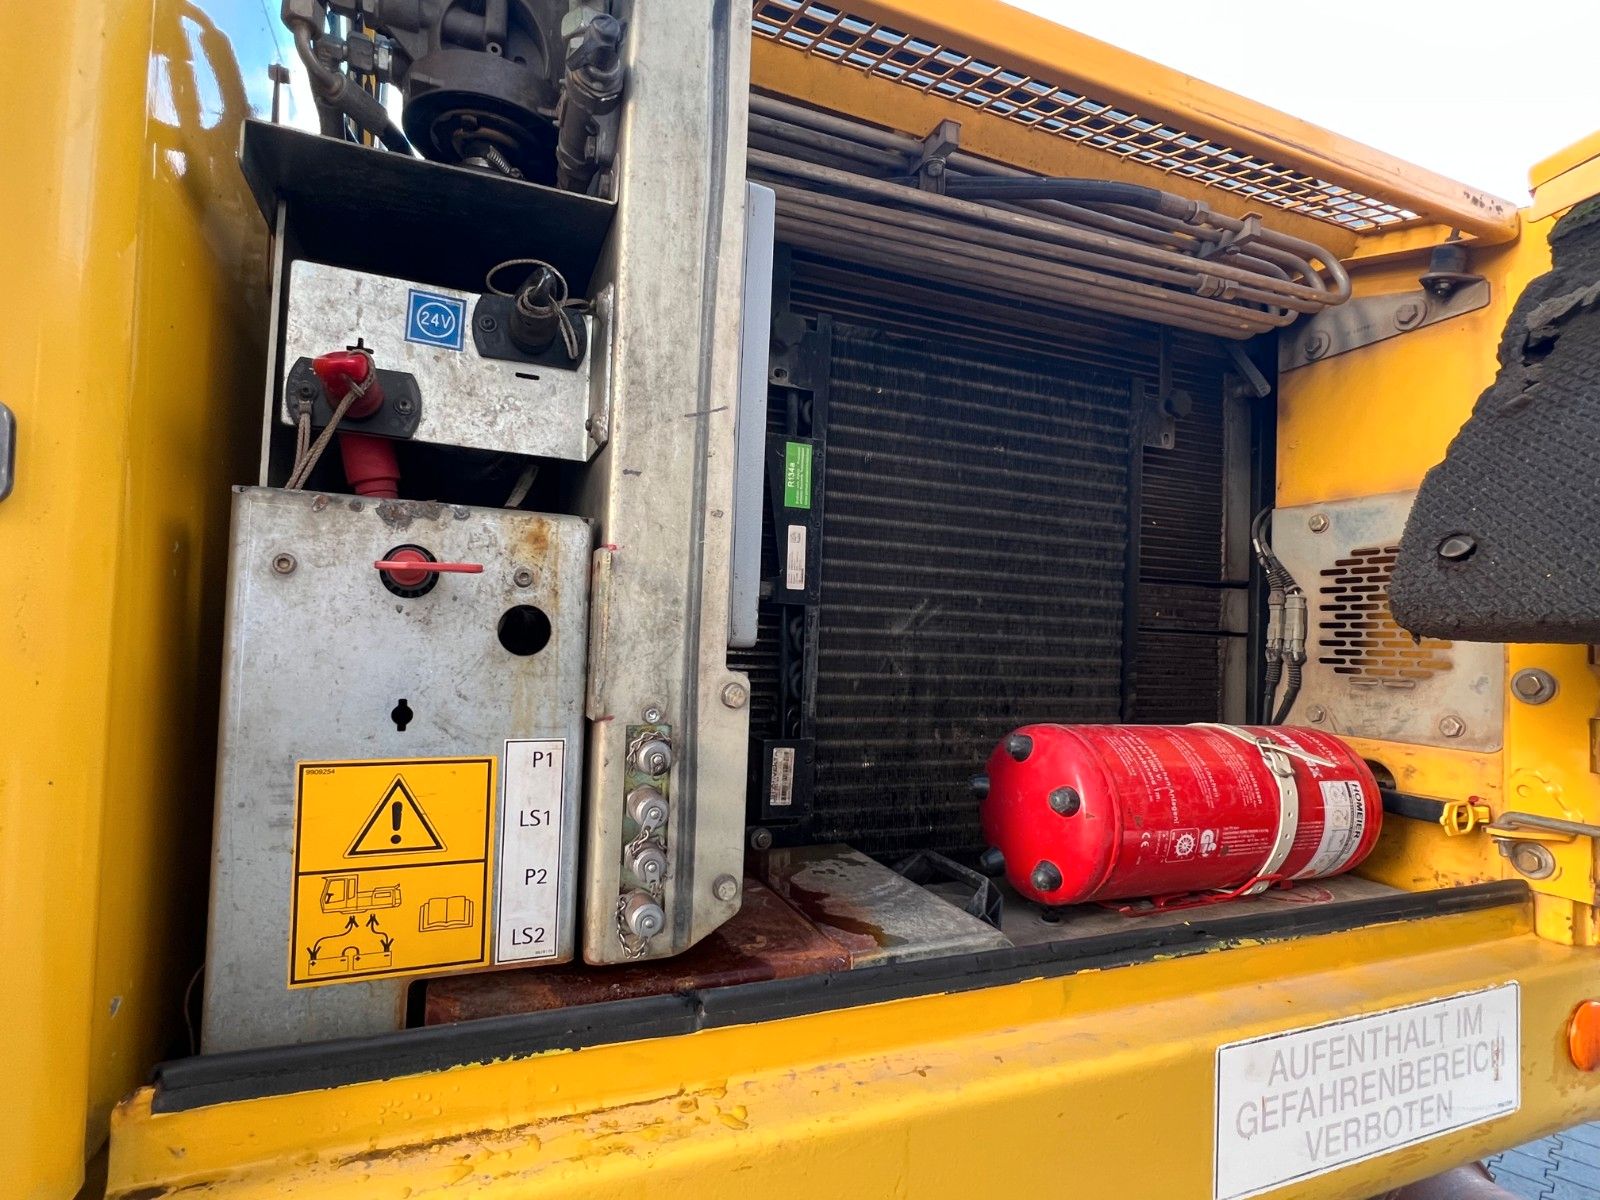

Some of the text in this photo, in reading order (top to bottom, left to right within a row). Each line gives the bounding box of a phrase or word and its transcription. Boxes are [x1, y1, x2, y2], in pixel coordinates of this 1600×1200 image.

[421, 311, 451, 329] 24V
[787, 462, 796, 488] R134a
[533, 751, 552, 768] P1
[520, 809, 550, 827] LS1
[1352, 783, 1363, 839] HOMEIER
[525, 868, 547, 886] P2
[512, 926, 545, 946] LS2
[1268, 1004, 1483, 1086] AUFENTHALT IM
[1236, 1036, 1505, 1140] GEFAHRENBEREICH
[1305, 1090, 1453, 1162] VERBOTEN
